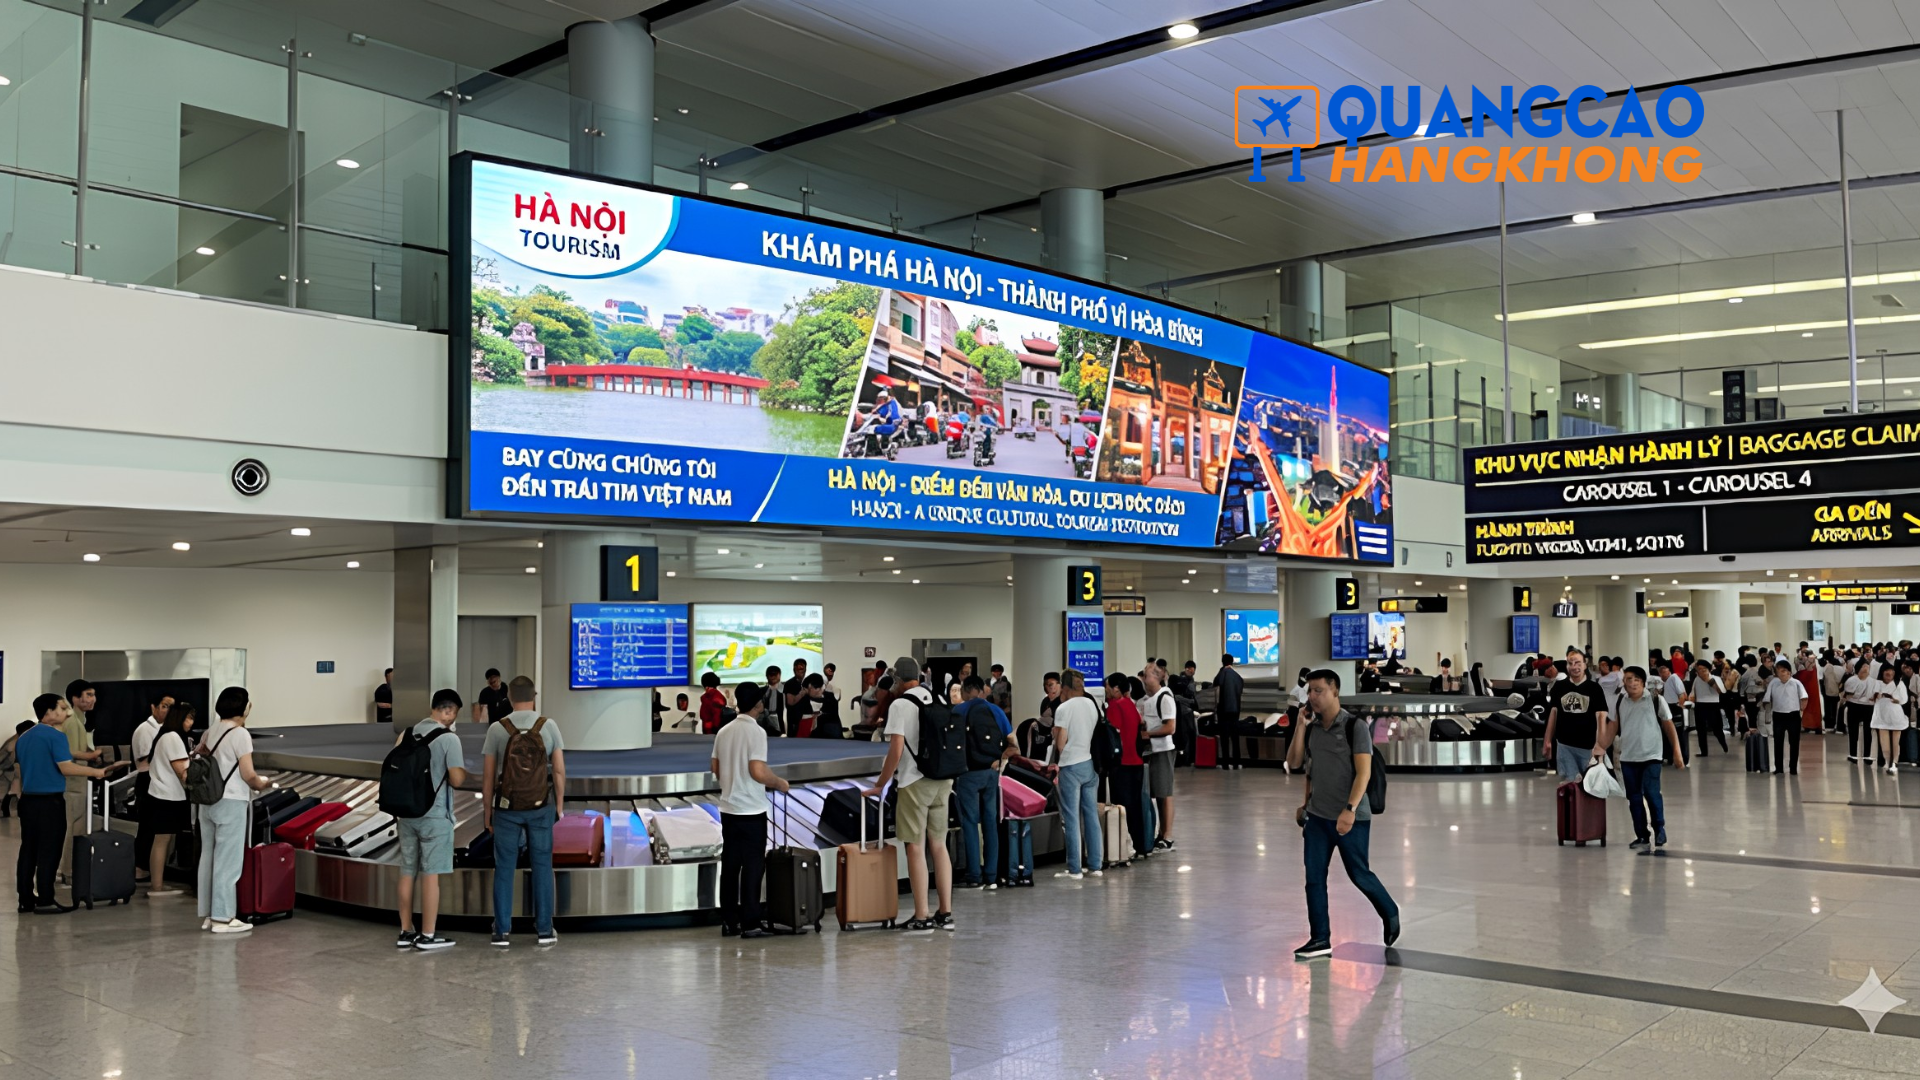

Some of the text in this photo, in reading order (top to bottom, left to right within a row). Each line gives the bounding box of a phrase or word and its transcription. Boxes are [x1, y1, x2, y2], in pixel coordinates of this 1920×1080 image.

[515, 192, 625, 239] HÀ NỘI
[519, 229, 620, 260] TOURISM
[762, 231, 842, 269] KHÁM
[849, 247, 899, 280] PHÁ
[906, 257, 939, 288] HÀ
[944, 266, 982, 300] NỘI
[502, 447, 544, 467] BAY
[1475, 455, 1516, 475] KHU
[1629, 440, 1692, 464] HÀNH
[1739, 429, 1846, 455] BAGGAGE
[601, 482, 638, 503] TIM
[688, 487, 732, 507] NAM
[1563, 481, 1657, 502] CAROUSEL
[1663, 480, 1670, 496] 1
[1688, 472, 1795, 494] CAROUSEL
[1798, 470, 1812, 486] 4
[625, 554, 640, 592] 1
[1083, 571, 1096, 601] 3
